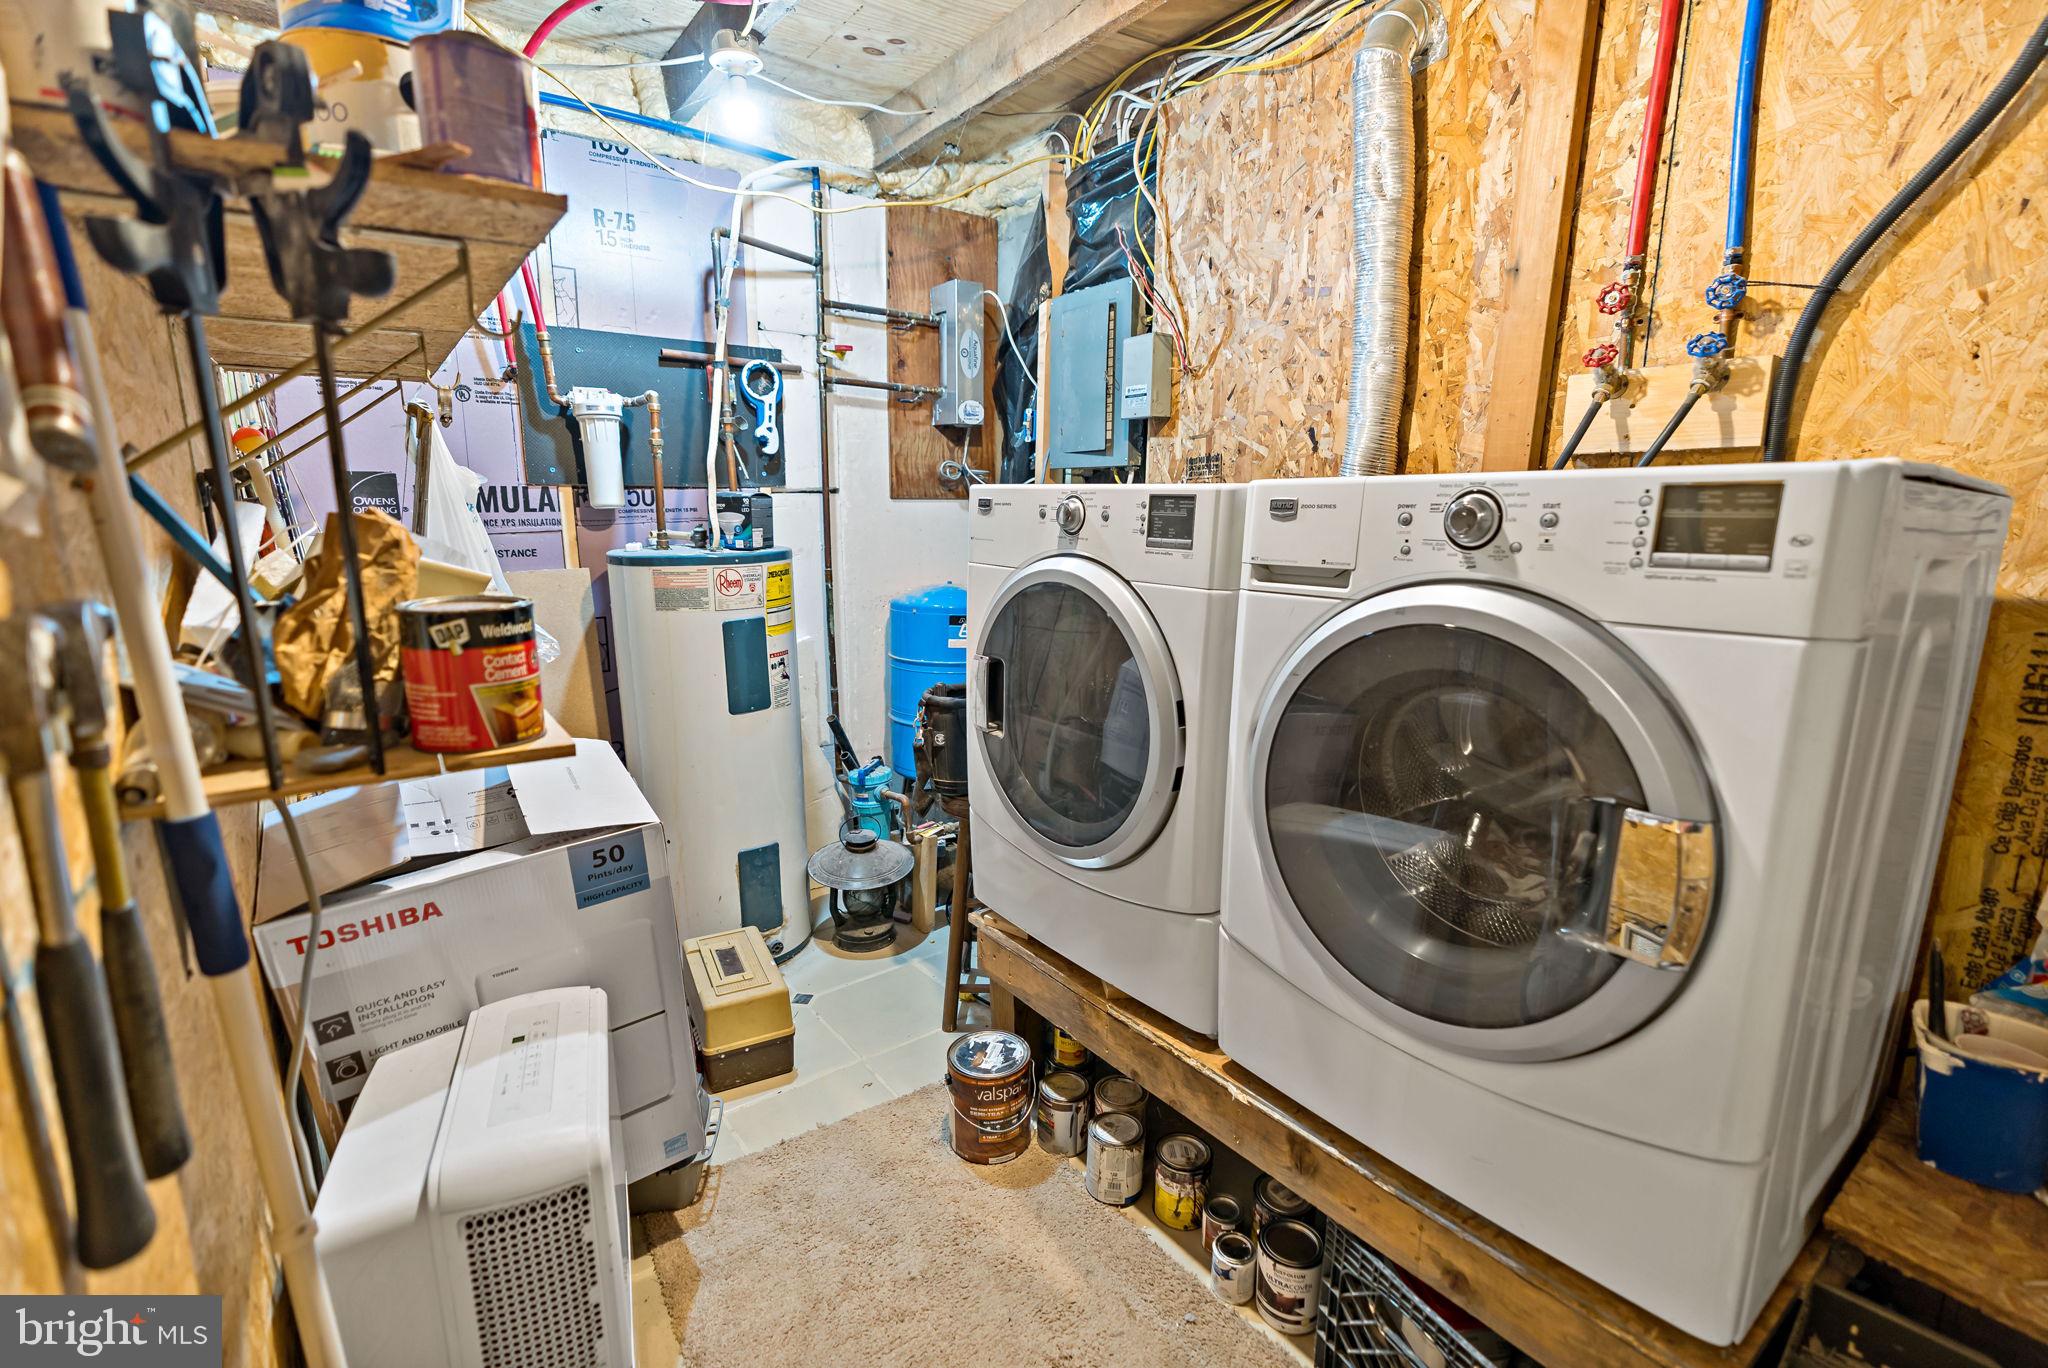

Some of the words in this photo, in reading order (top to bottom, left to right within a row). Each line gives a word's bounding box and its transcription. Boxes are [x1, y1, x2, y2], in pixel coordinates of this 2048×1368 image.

[593, 208, 636, 232] R-7.5
[353, 496, 397, 505] OWENS
[476, 486, 560, 513] MULA
[627, 489, 655, 507] 50
[483, 518, 498, 527] NCE
[501, 518, 516, 528] XPS
[518, 518, 562, 527] INSULATION
[495, 548, 538, 558] STANCE
[719, 570, 742, 593] Rheem
[434, 622, 465, 643] DAP
[480, 619, 532, 639] Weldwood
[483, 651, 527, 669] Contact
[484, 665, 528, 682] Cement
[592, 844, 625, 868] 50
[587, 863, 634, 882] Pints/day
[583, 892, 605, 903] HIGH
[605, 880, 643, 896] CAPACITY
[286, 901, 444, 955] TOSHIBA
[492, 967, 519, 978] TOSHIBA
[355, 996, 391, 1014] QUICK
[393, 988, 417, 1001] AND
[419, 979, 446, 993] EASY
[357, 992, 435, 1023] INSTALLATION
[367, 1040, 398, 1057] LIGHT
[401, 1033, 424, 1047] AND
[425, 1019, 464, 1038] MOBILE
[974, 1086, 1022, 1102] valspar
